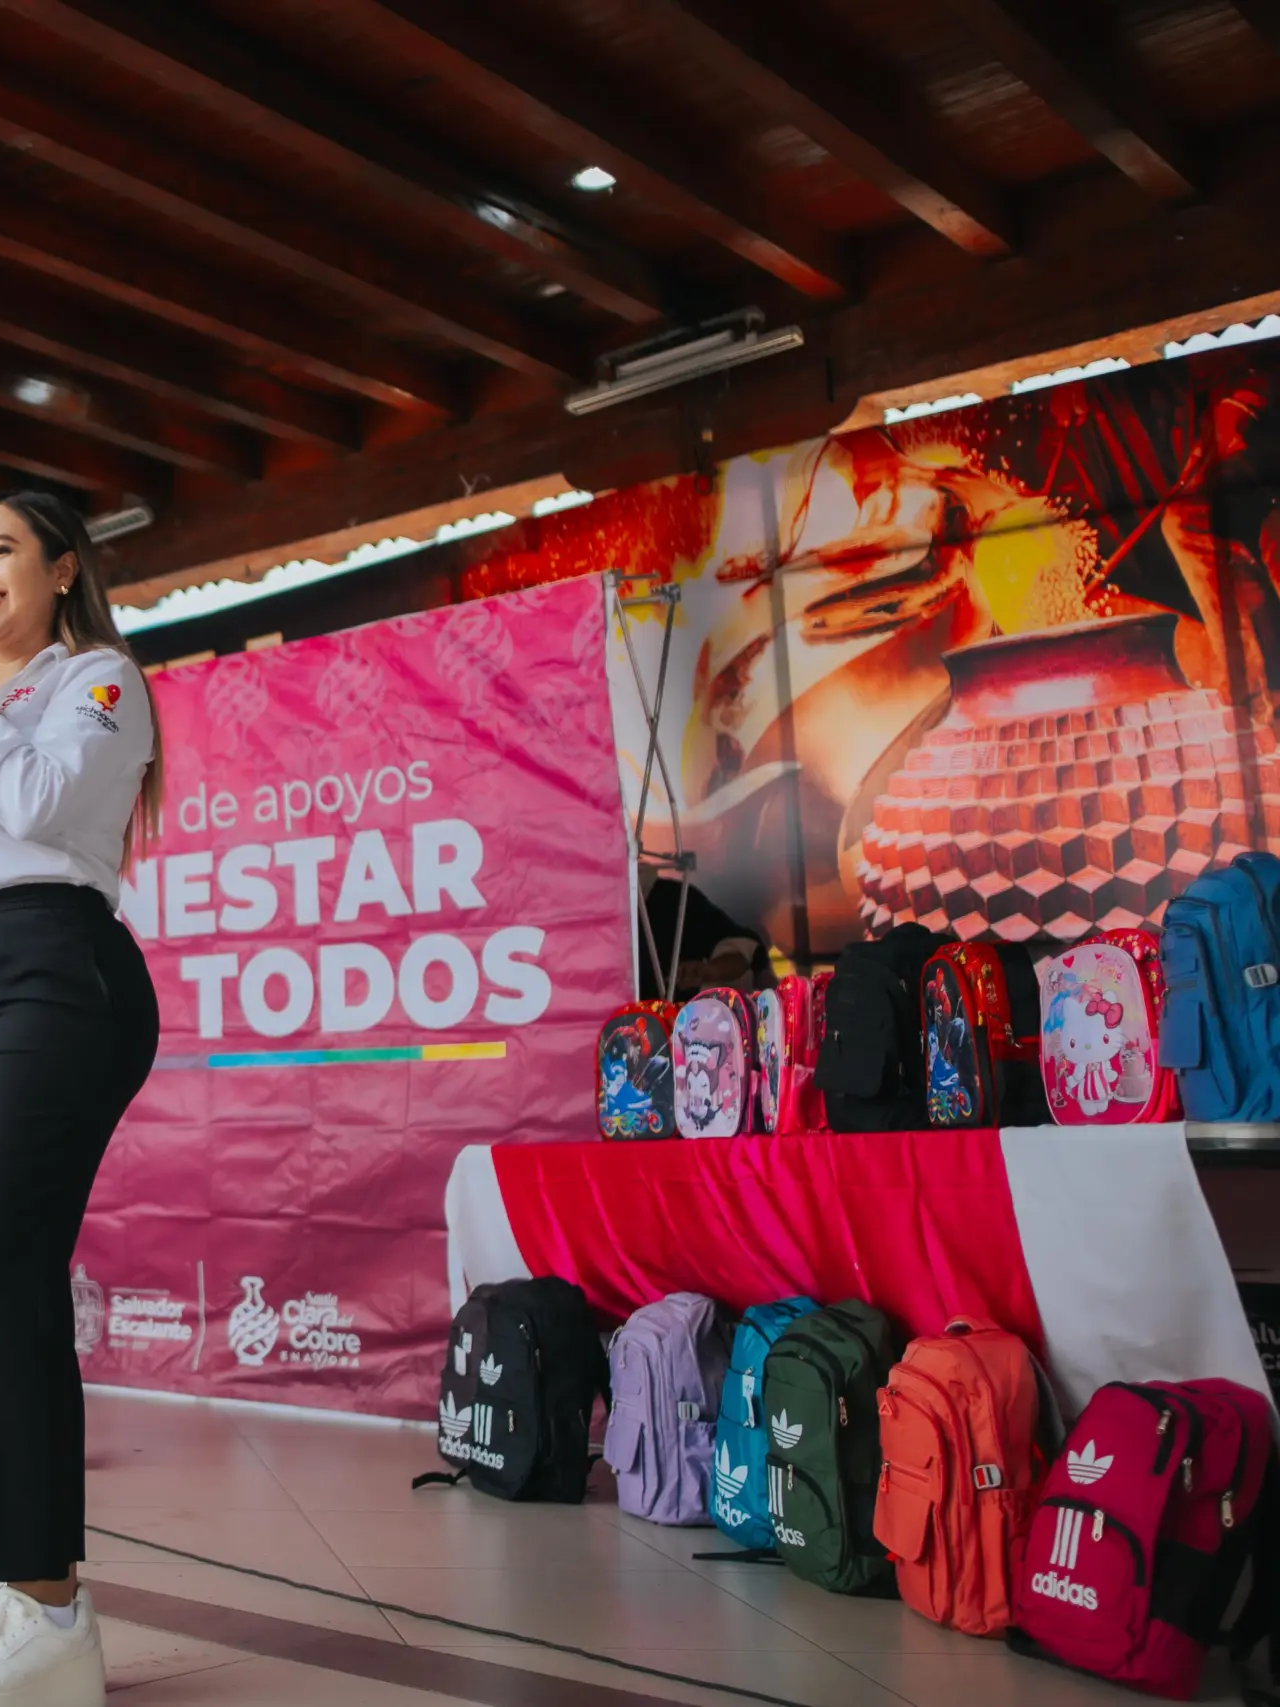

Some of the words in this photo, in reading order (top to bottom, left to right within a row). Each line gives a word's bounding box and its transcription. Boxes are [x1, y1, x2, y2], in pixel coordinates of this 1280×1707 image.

[178, 782, 238, 834] de
[253, 760, 434, 832] apoyos
[180, 925, 552, 1040] TODOS
[282, 1299, 339, 1328] Clara
[289, 1324, 362, 1355] Cobre
[1031, 1570, 1099, 1612] adidas
